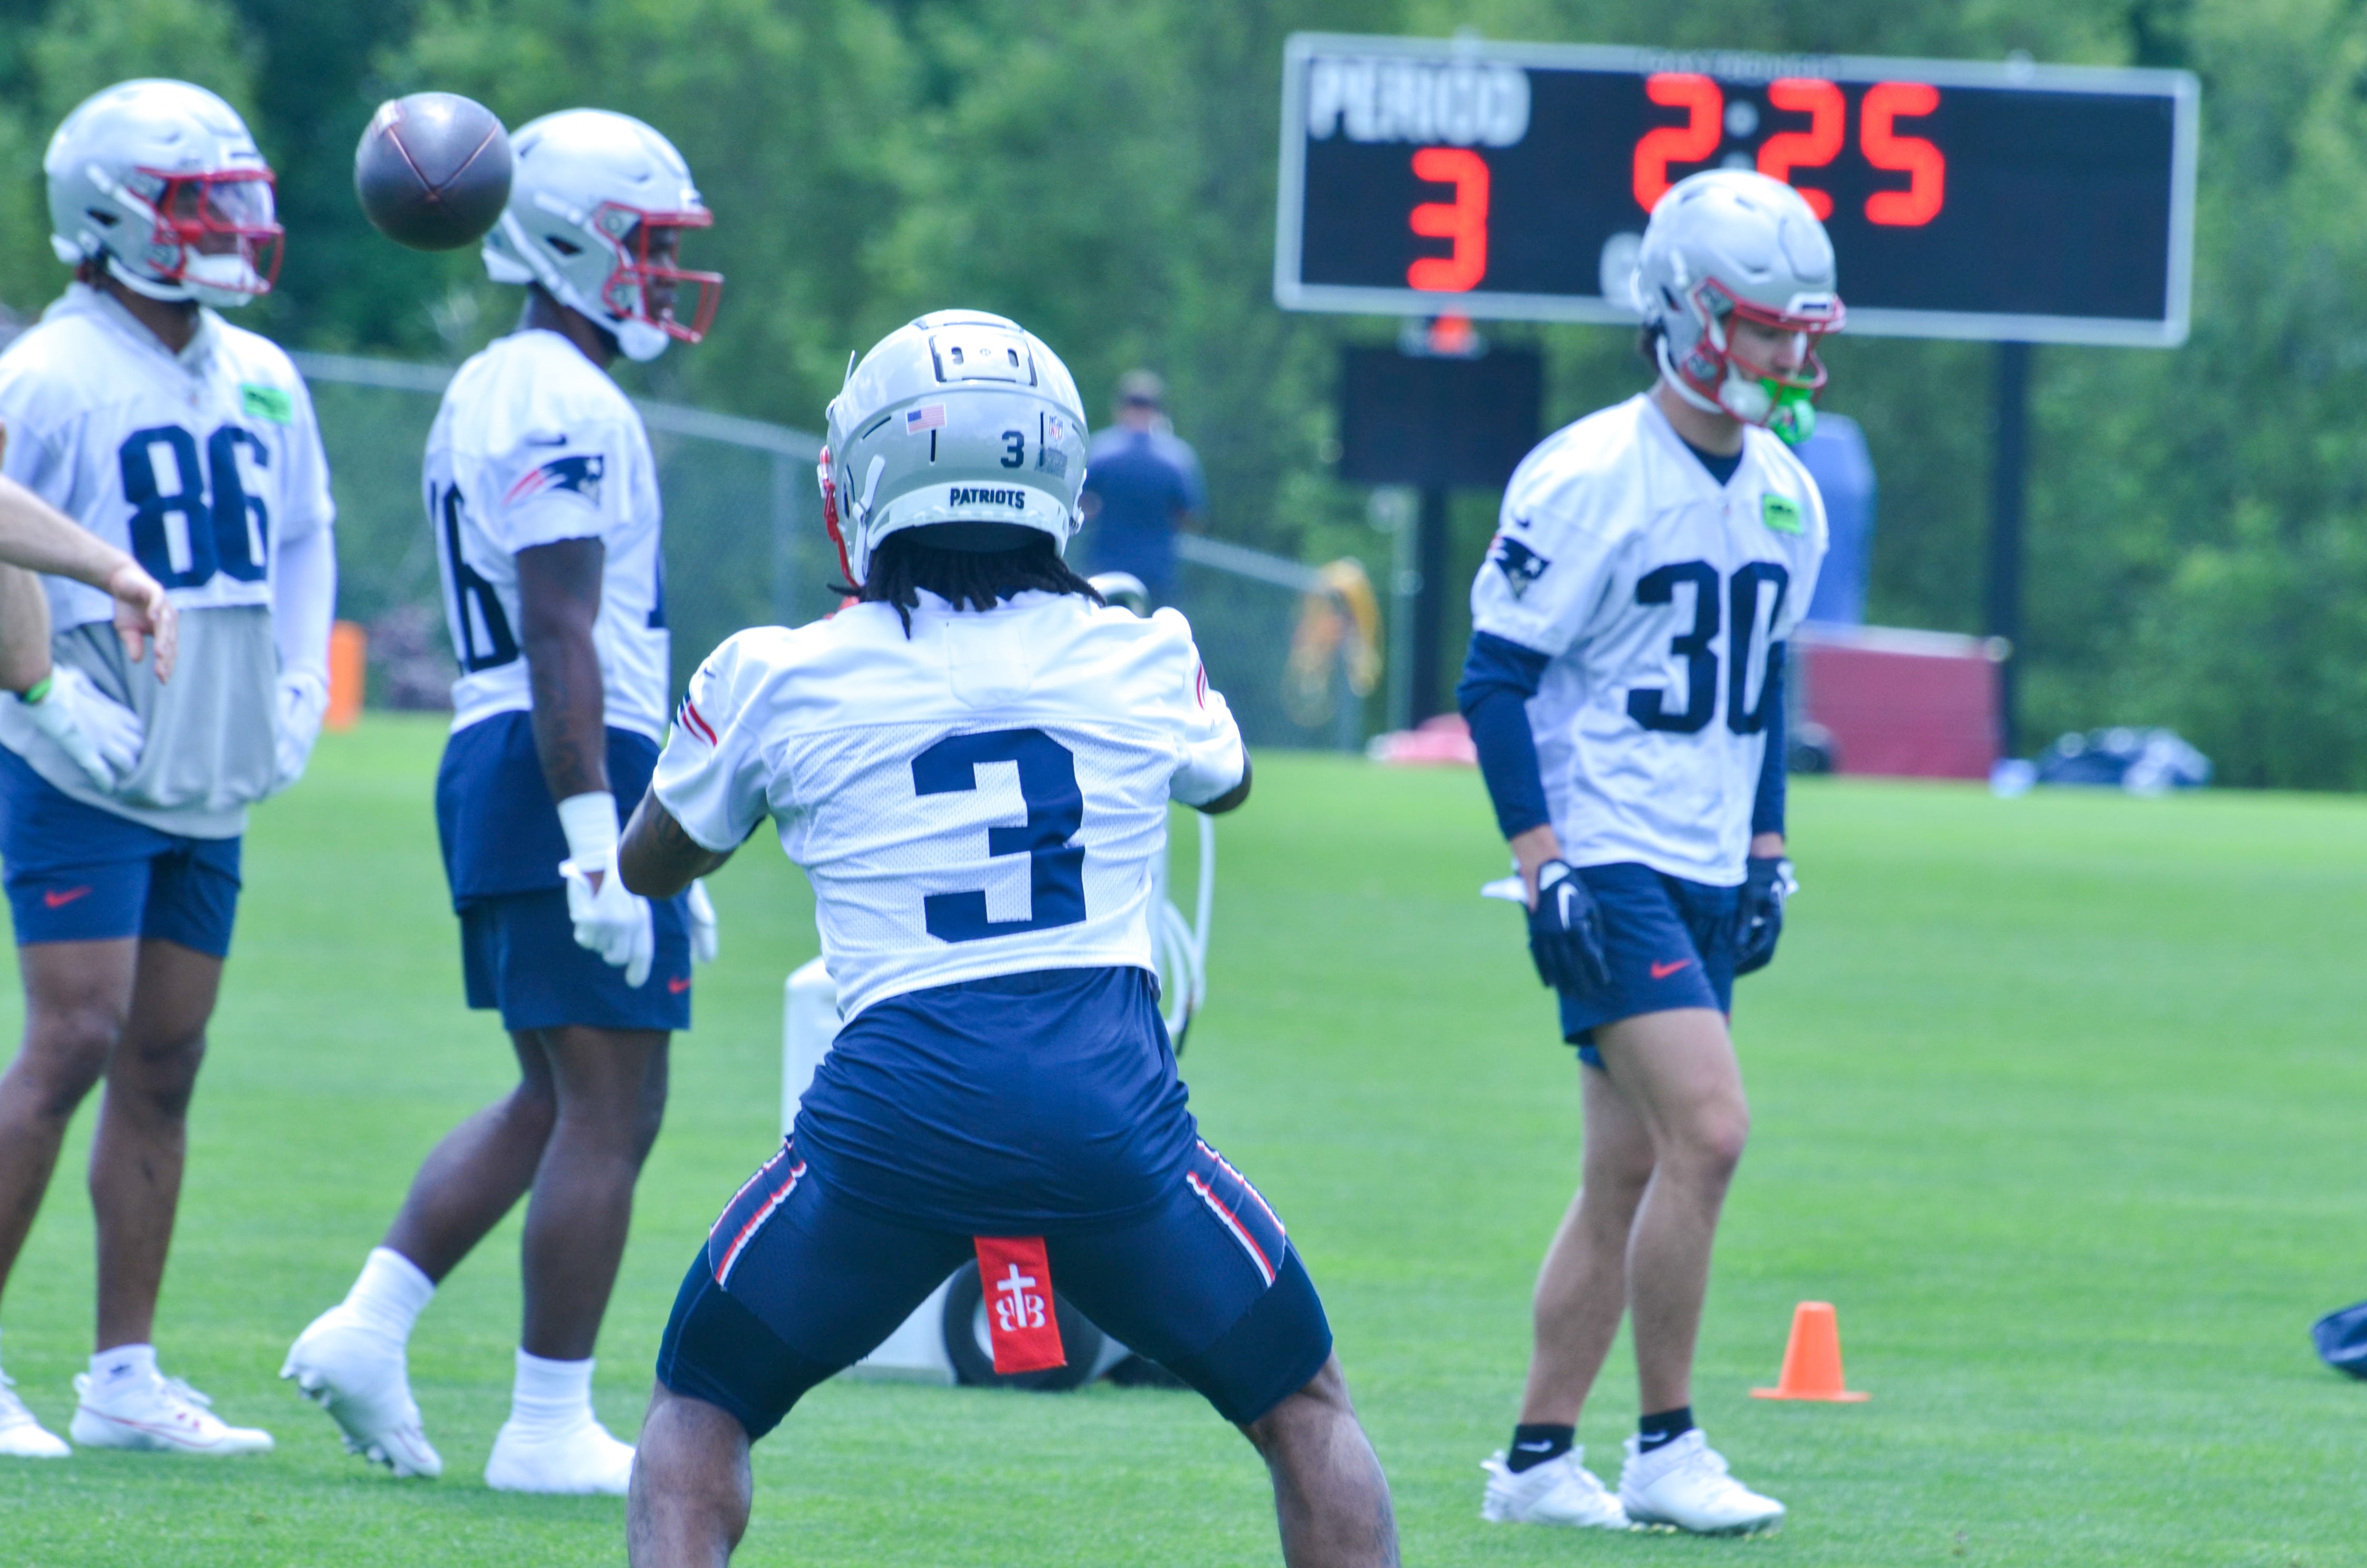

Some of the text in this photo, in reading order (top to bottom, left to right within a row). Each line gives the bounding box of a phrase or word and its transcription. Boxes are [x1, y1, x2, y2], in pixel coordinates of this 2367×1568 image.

[1406, 148, 1489, 292] 3
[119, 425, 269, 589] 86
[950, 487, 1025, 509] PATRIOTS
[1001, 431, 1024, 468] 3
[1628, 560, 1789, 735] 30
[911, 728, 1086, 943] 3
